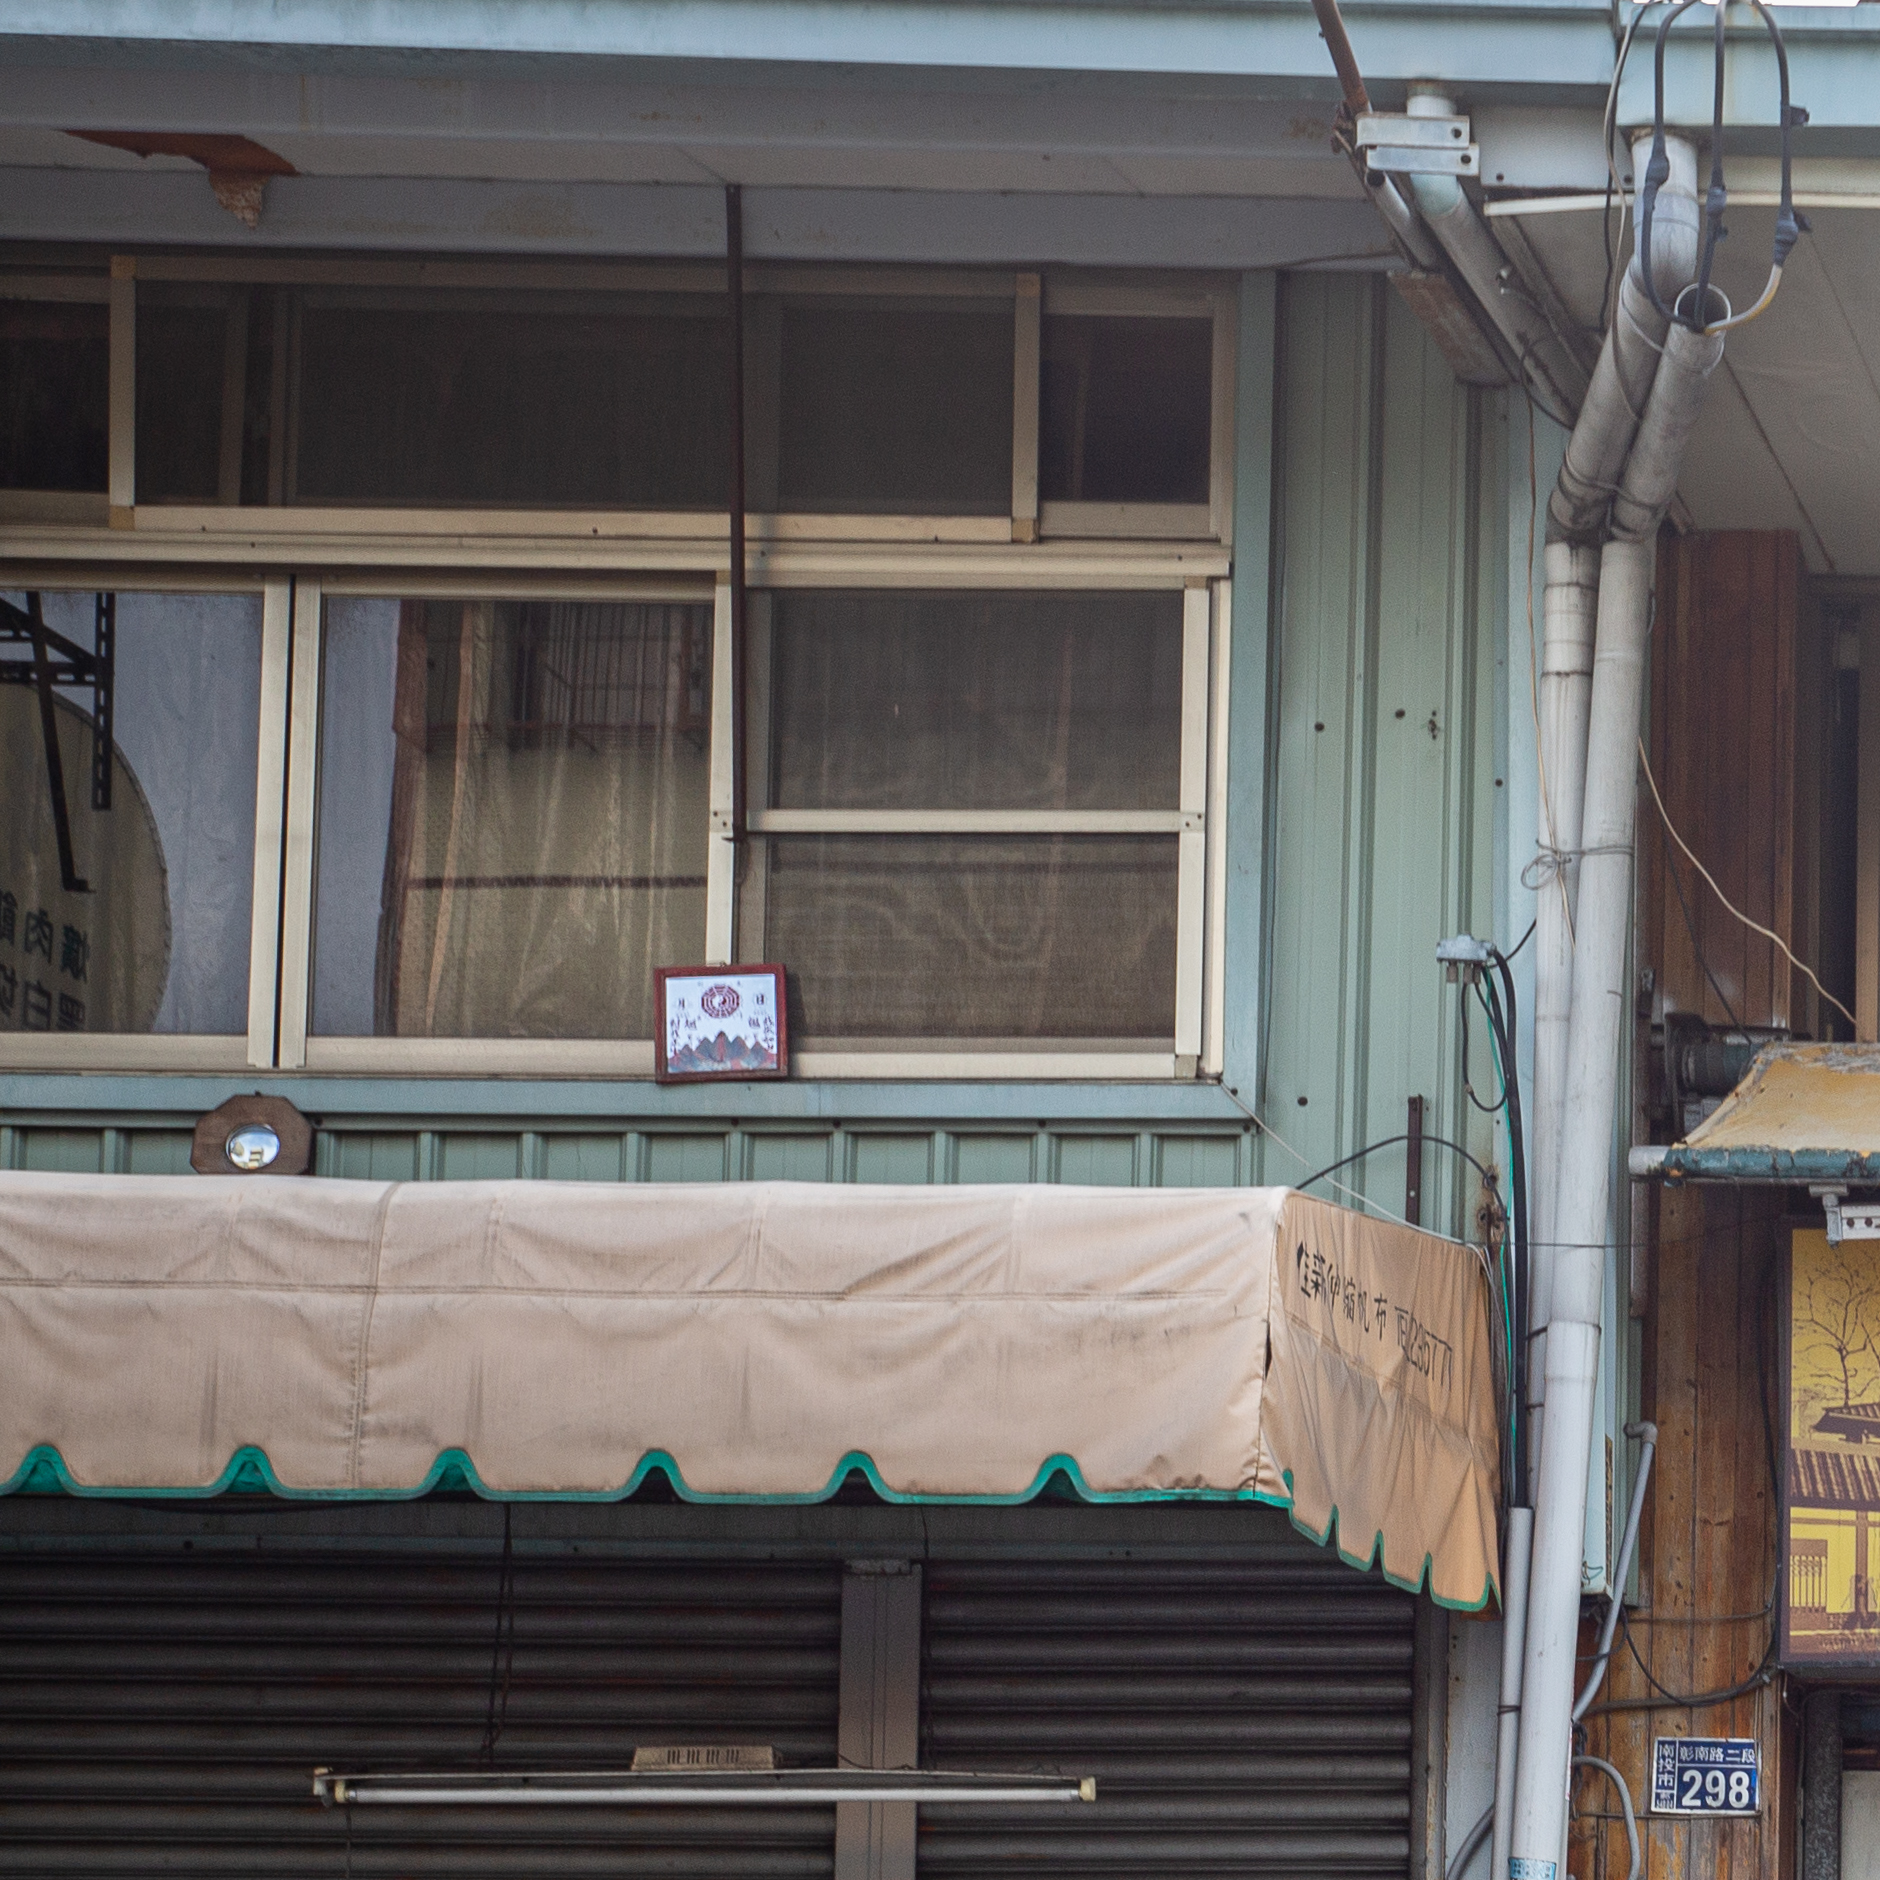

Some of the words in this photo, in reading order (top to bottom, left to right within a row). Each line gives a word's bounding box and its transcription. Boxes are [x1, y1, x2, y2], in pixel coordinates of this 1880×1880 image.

[1657, 1744, 1675, 1787] 南投市
[1680, 1746, 1755, 1763] 彰南路二段
[1682, 1769, 1750, 1808] 298
